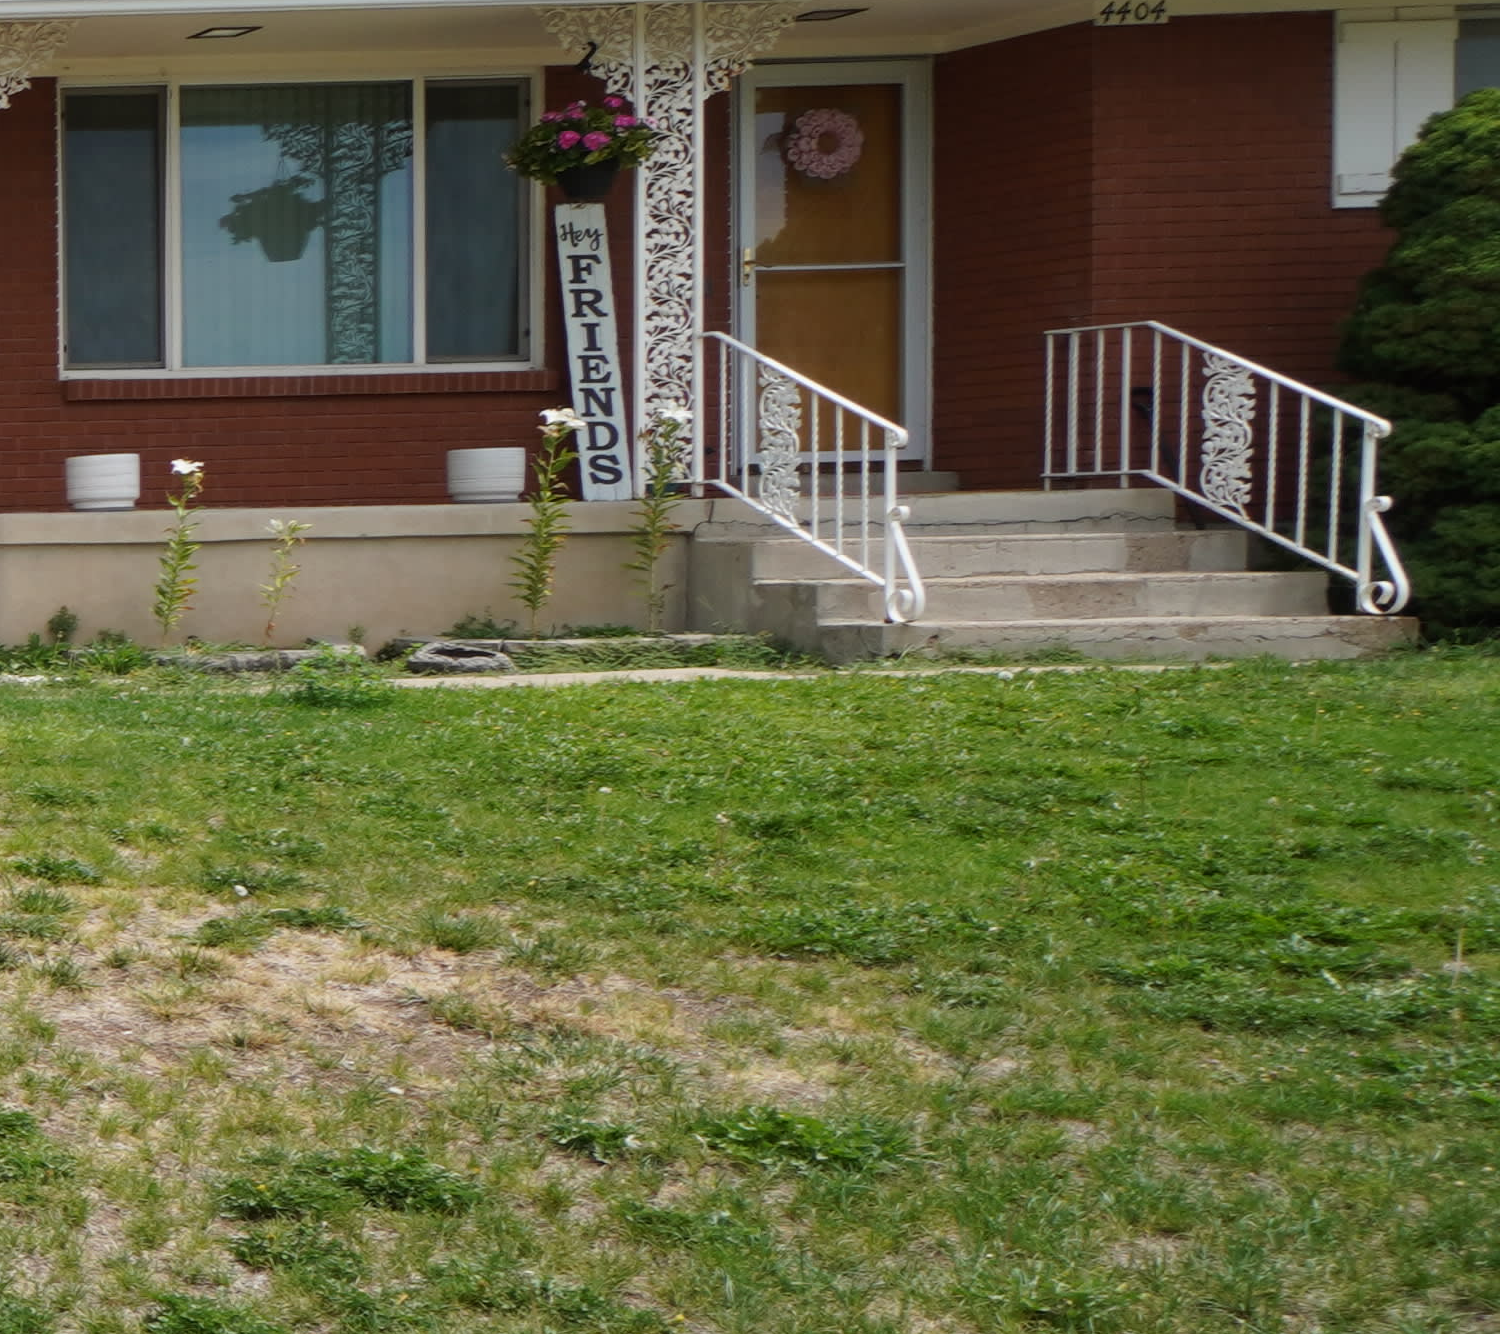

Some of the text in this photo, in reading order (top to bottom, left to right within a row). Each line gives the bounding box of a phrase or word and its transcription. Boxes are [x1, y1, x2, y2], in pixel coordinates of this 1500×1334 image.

[1100, 0, 1166, 24] 4404
[559, 222, 604, 251] Hey
[566, 254, 624, 485] FRIENDS
